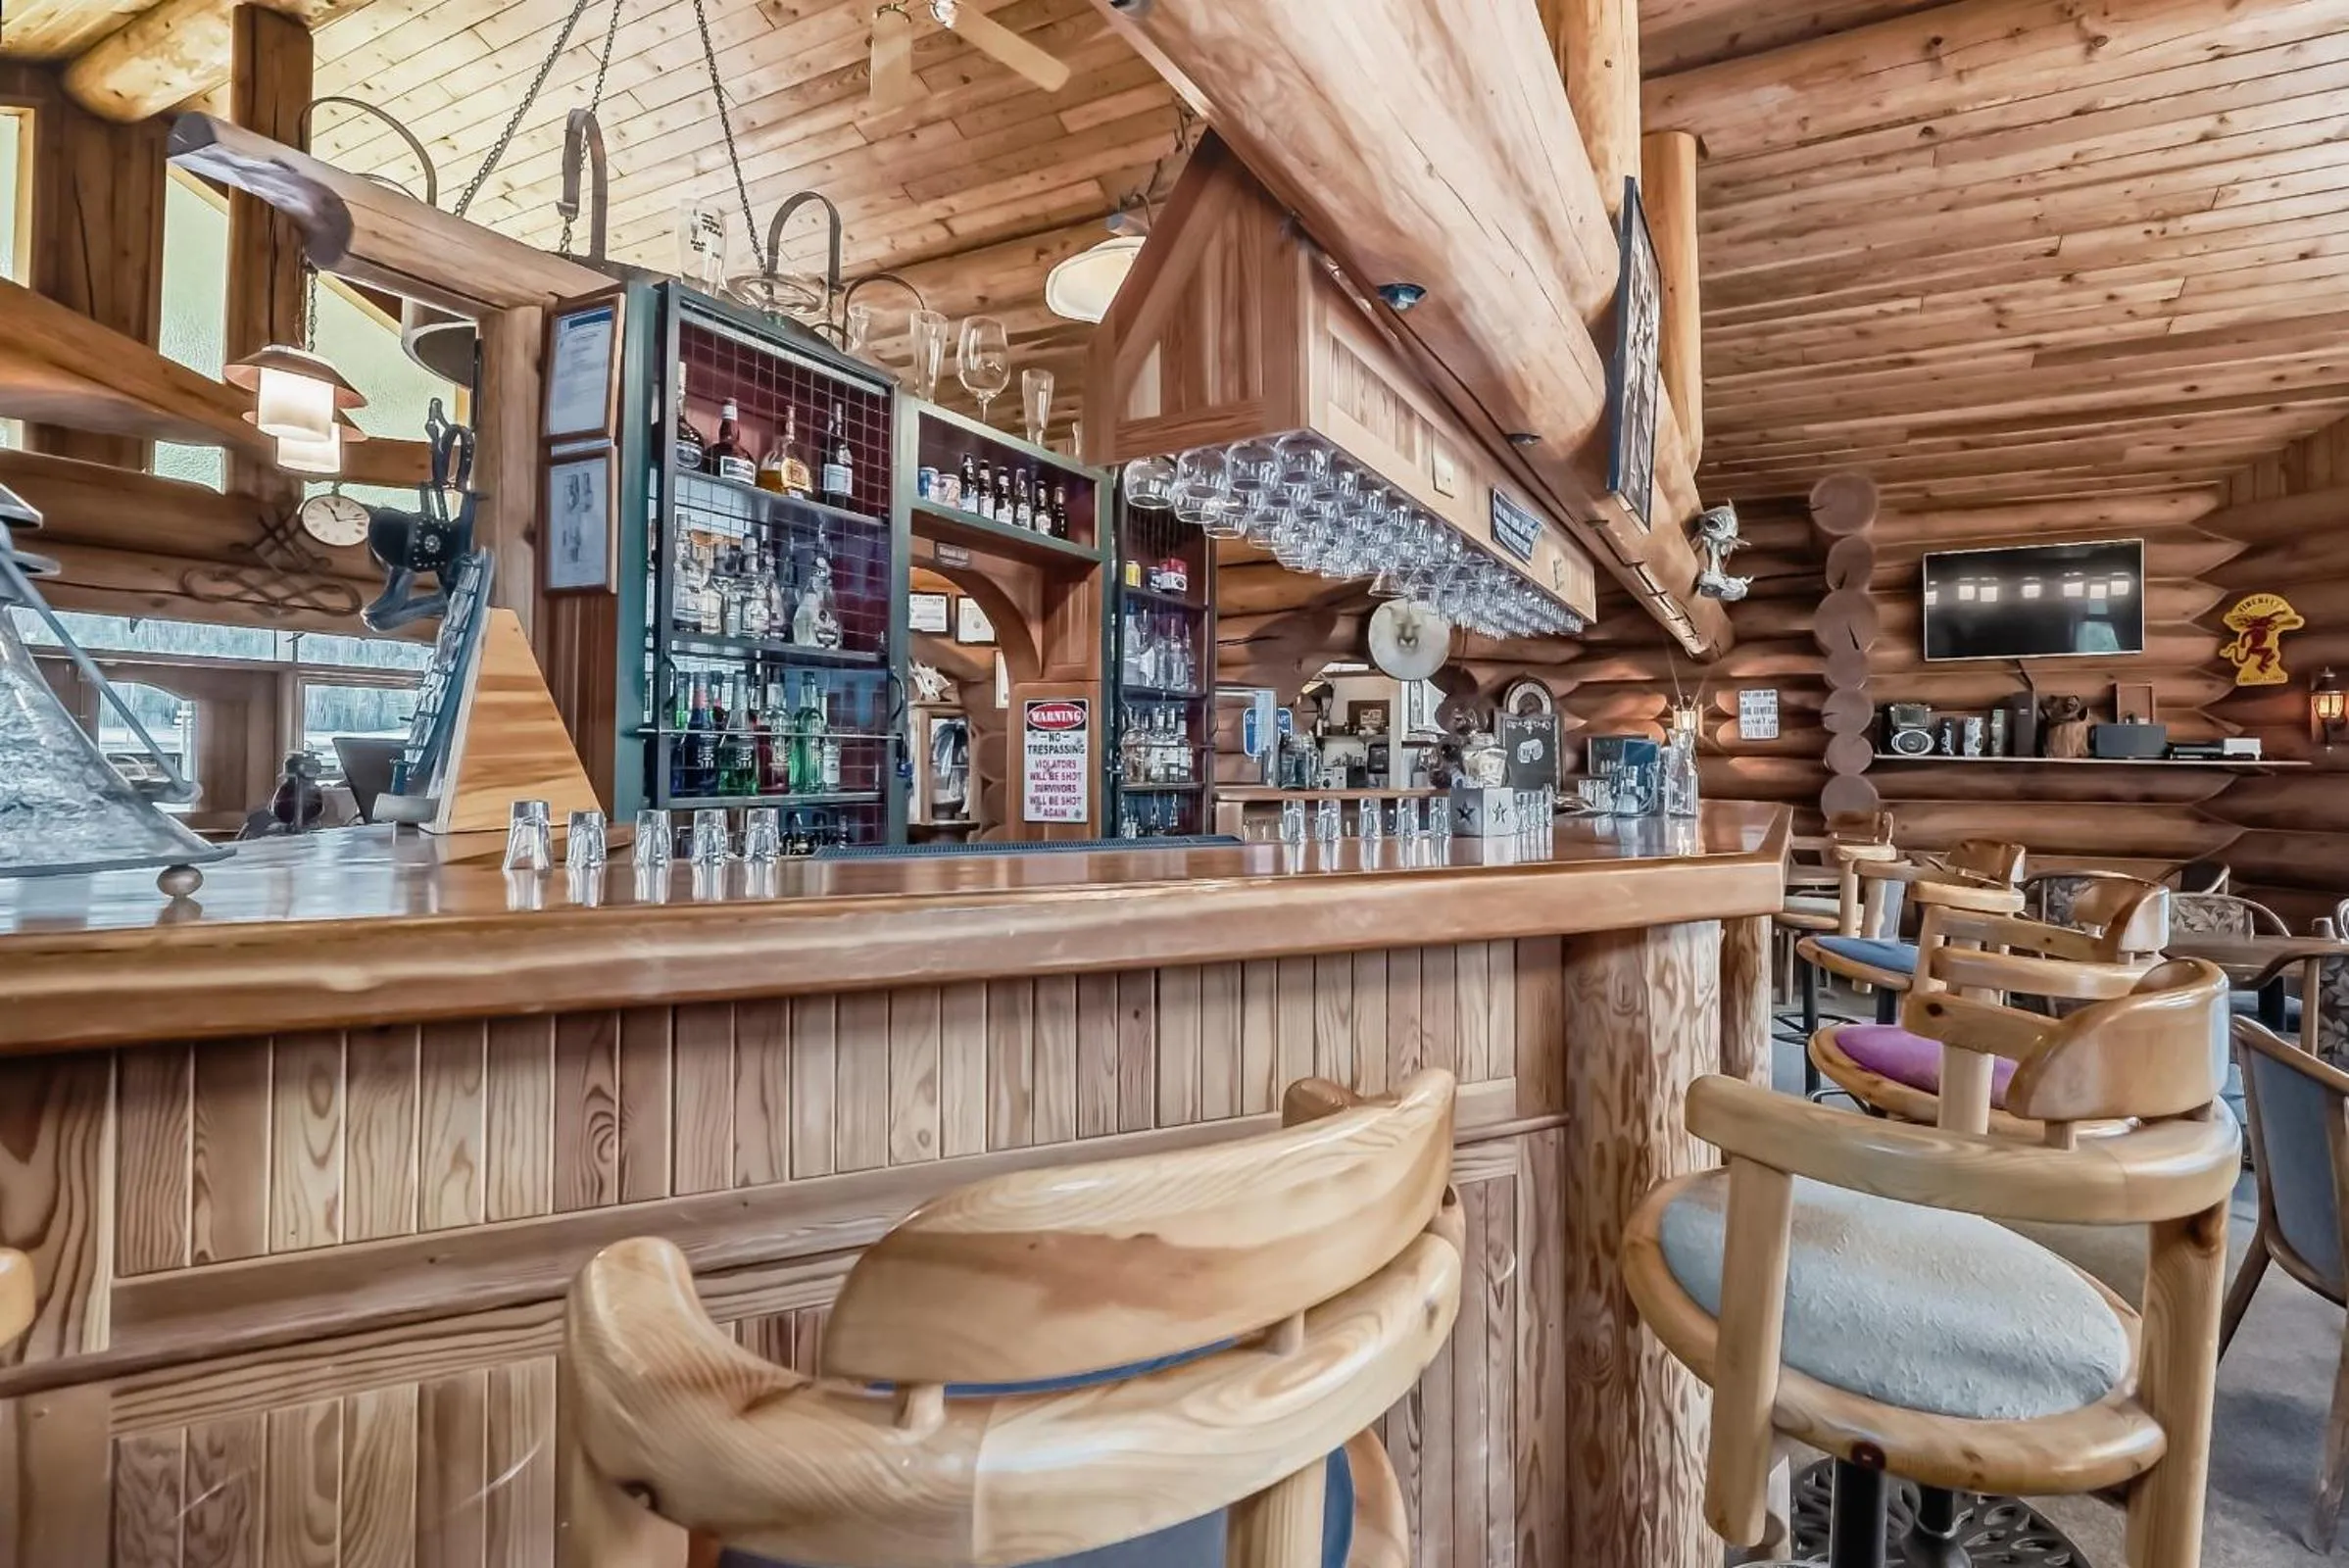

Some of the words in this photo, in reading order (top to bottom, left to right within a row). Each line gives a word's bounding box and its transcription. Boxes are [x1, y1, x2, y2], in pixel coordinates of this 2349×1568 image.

[1031, 710, 1081, 723] WARNING
[1049, 732, 1060, 742] NO
[1027, 745, 1085, 755] TRESPASSING
[1035, 760, 1076, 769] VIOLATORS
[1030, 771, 1047, 781] WILL
[1049, 771, 1059, 781] BE
[1061, 771, 1082, 781] SHOT
[1034, 784, 1076, 793] SURVIVORS
[1029, 795, 1047, 805] WILL
[1049, 796, 1058, 806] BE
[1061, 796, 1082, 806] SHOT
[1043, 808, 1067, 816] AGAIN
